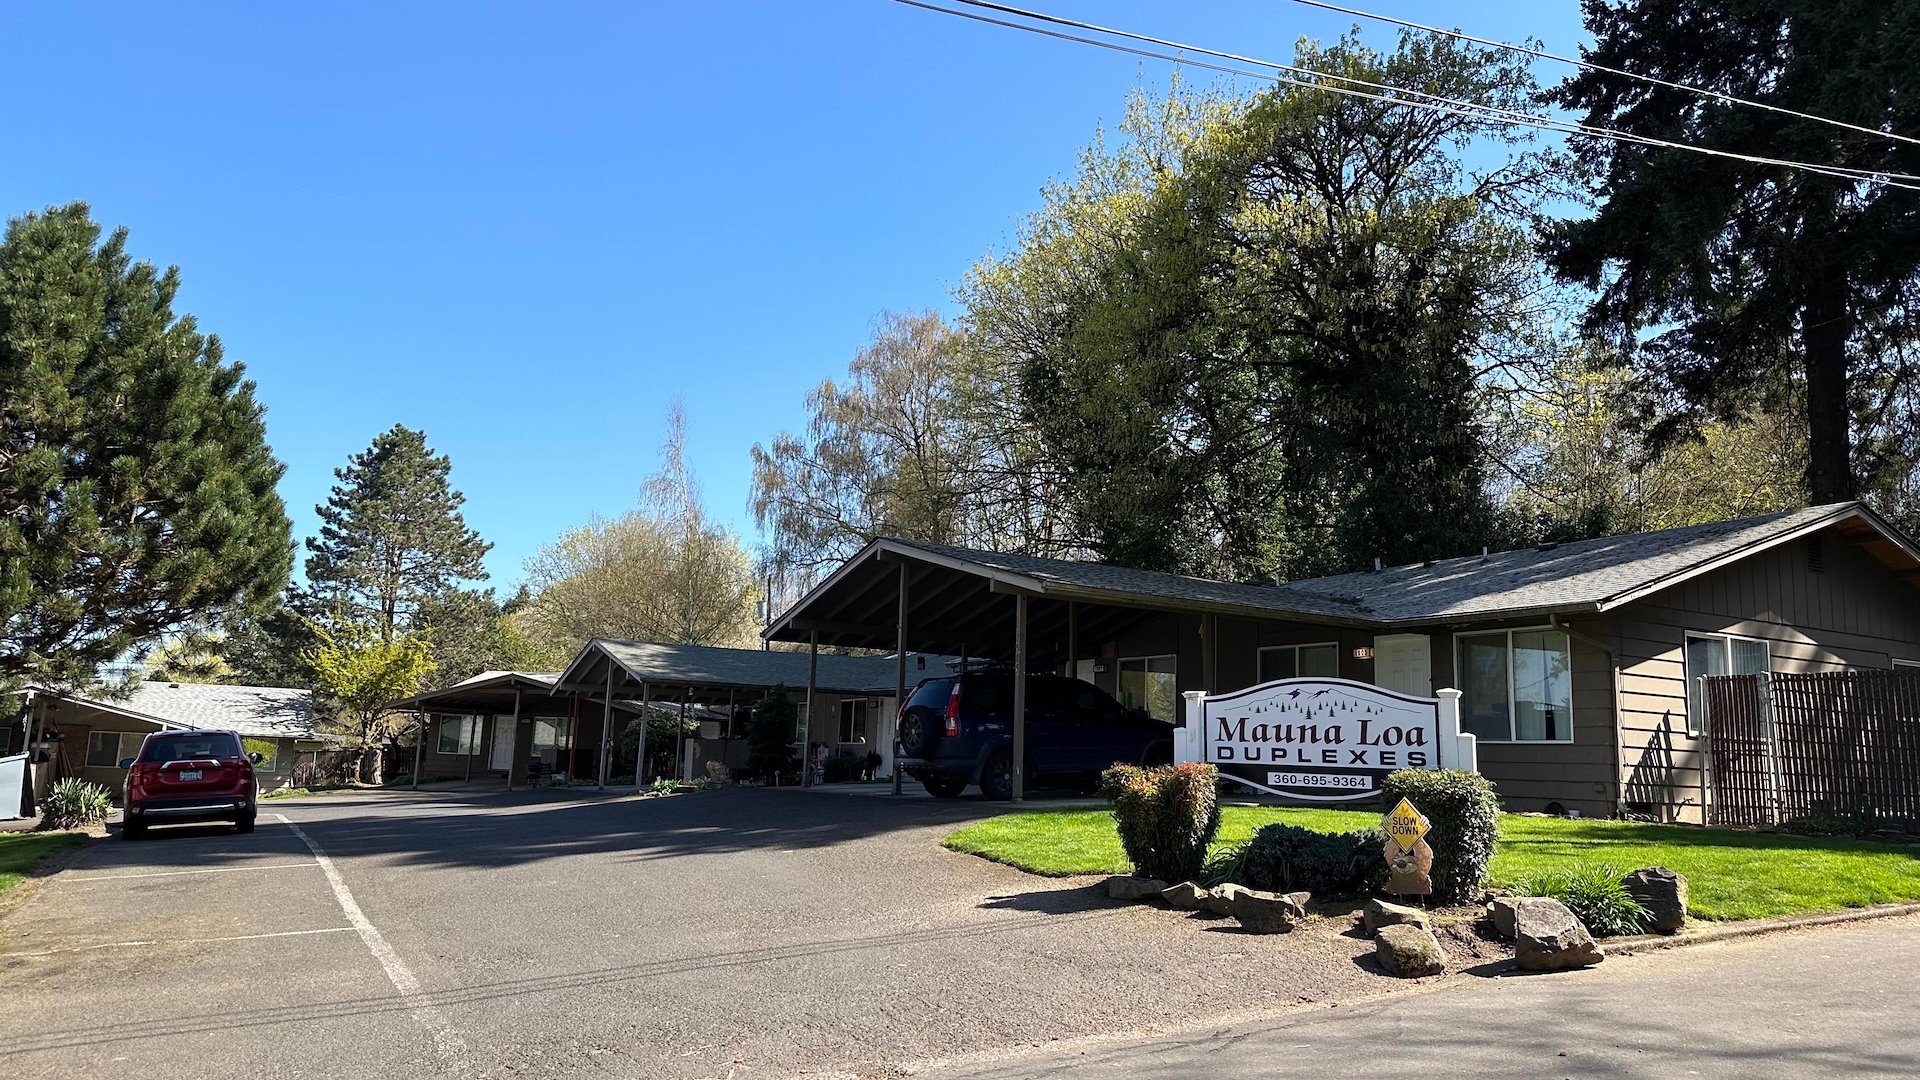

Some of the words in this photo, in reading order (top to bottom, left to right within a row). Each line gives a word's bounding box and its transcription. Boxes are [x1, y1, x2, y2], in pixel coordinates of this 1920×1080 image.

[1214, 717, 1345, 744] Mauna
[1356, 719, 1429, 747] Loa
[1217, 746, 1427, 767] DUPLEXES
[1273, 773, 1366, 788] 360-695-9364
[1392, 816, 1417, 826] SLOW
[1392, 826, 1419, 835] DOWN
